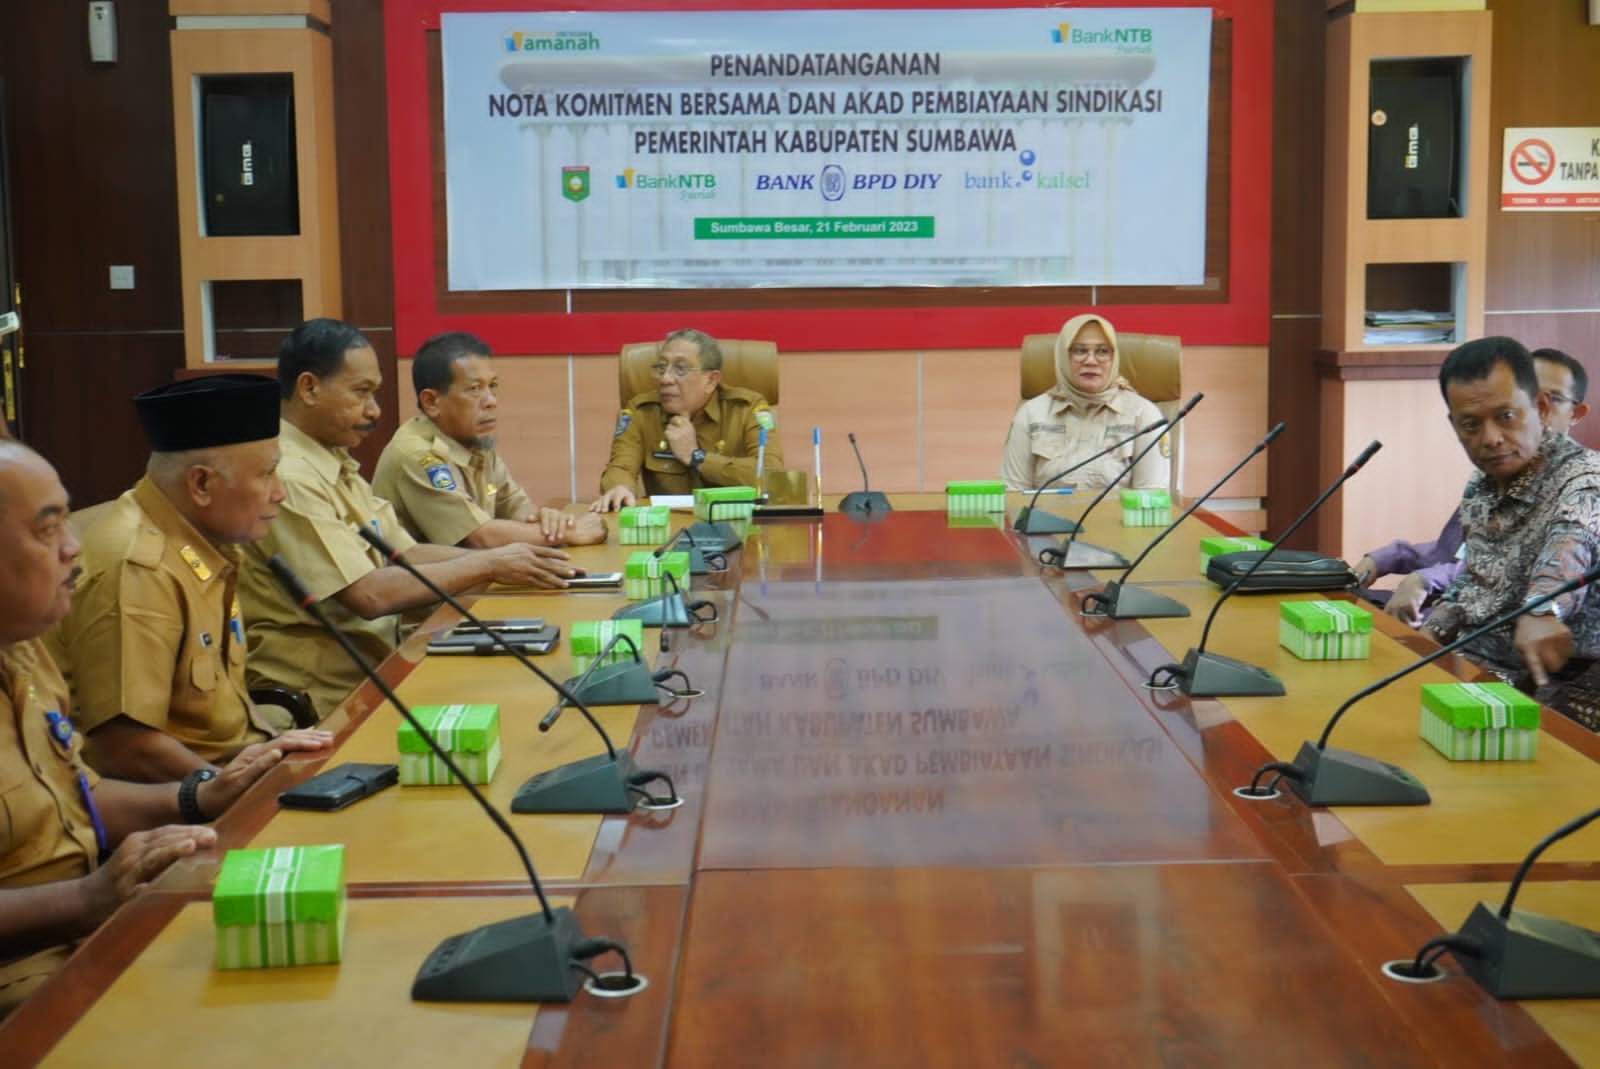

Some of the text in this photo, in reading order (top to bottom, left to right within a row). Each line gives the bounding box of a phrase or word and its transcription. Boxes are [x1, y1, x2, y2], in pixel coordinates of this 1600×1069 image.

[523, 31, 600, 51] amanah
[1071, 28, 1153, 44] BankNTB
[710, 52, 940, 77] PENANDATANGANAN
[489, 88, 1163, 118] NOTA KOMITMEN BERSAMA DAN AKAD PEMBIAYAAN SINDIKASI
[634, 128, 1017, 154] PEMERINTAH KABUPATEN SUMBAWA
[1560, 161, 1599, 182] TANPA
[636, 174, 716, 190] BankNTB
[756, 174, 815, 190] BANK
[852, 173, 943, 190] BPD DIY
[711, 221, 919, 235] Sumbawa Besar, 21 Februari 2023
